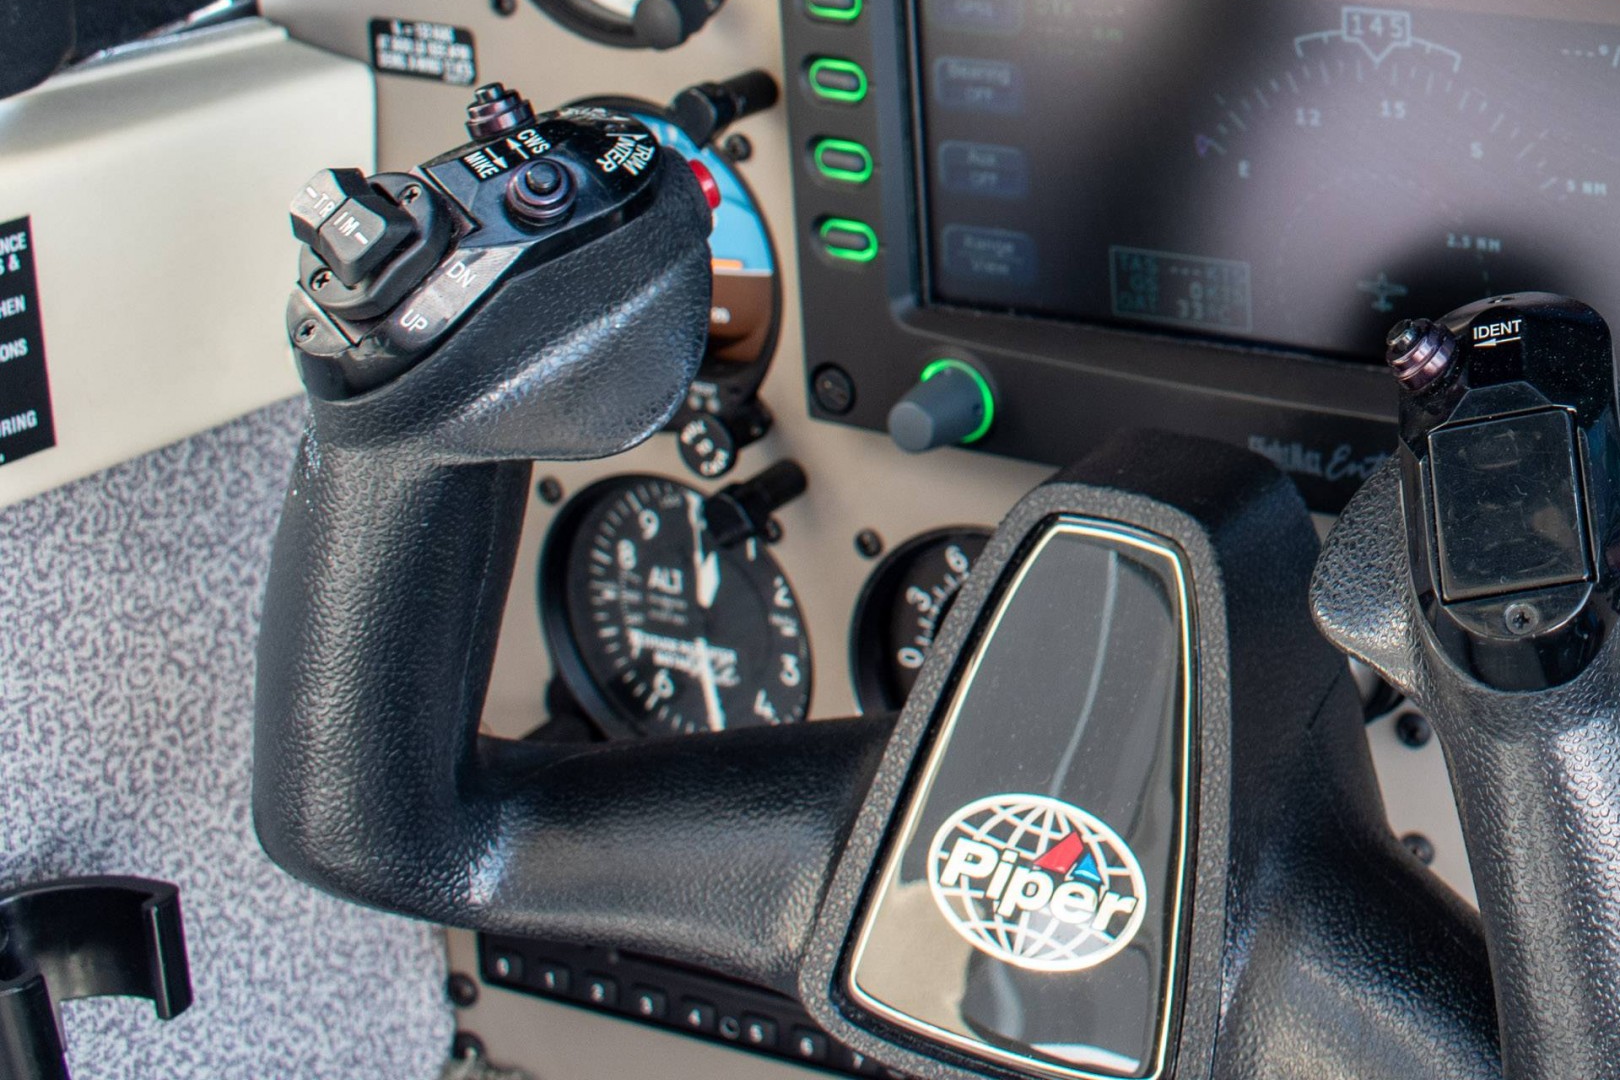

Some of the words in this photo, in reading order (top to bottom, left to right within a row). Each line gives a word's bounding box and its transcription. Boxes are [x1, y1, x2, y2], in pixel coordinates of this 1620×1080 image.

[516, 128, 550, 156] CWS
[462, 151, 499, 180] MIKE
[446, 262, 476, 288] DN
[400, 309, 428, 333] UP
[1473, 319, 1522, 339] IDENT
[941, 838, 1138, 931] Piper
